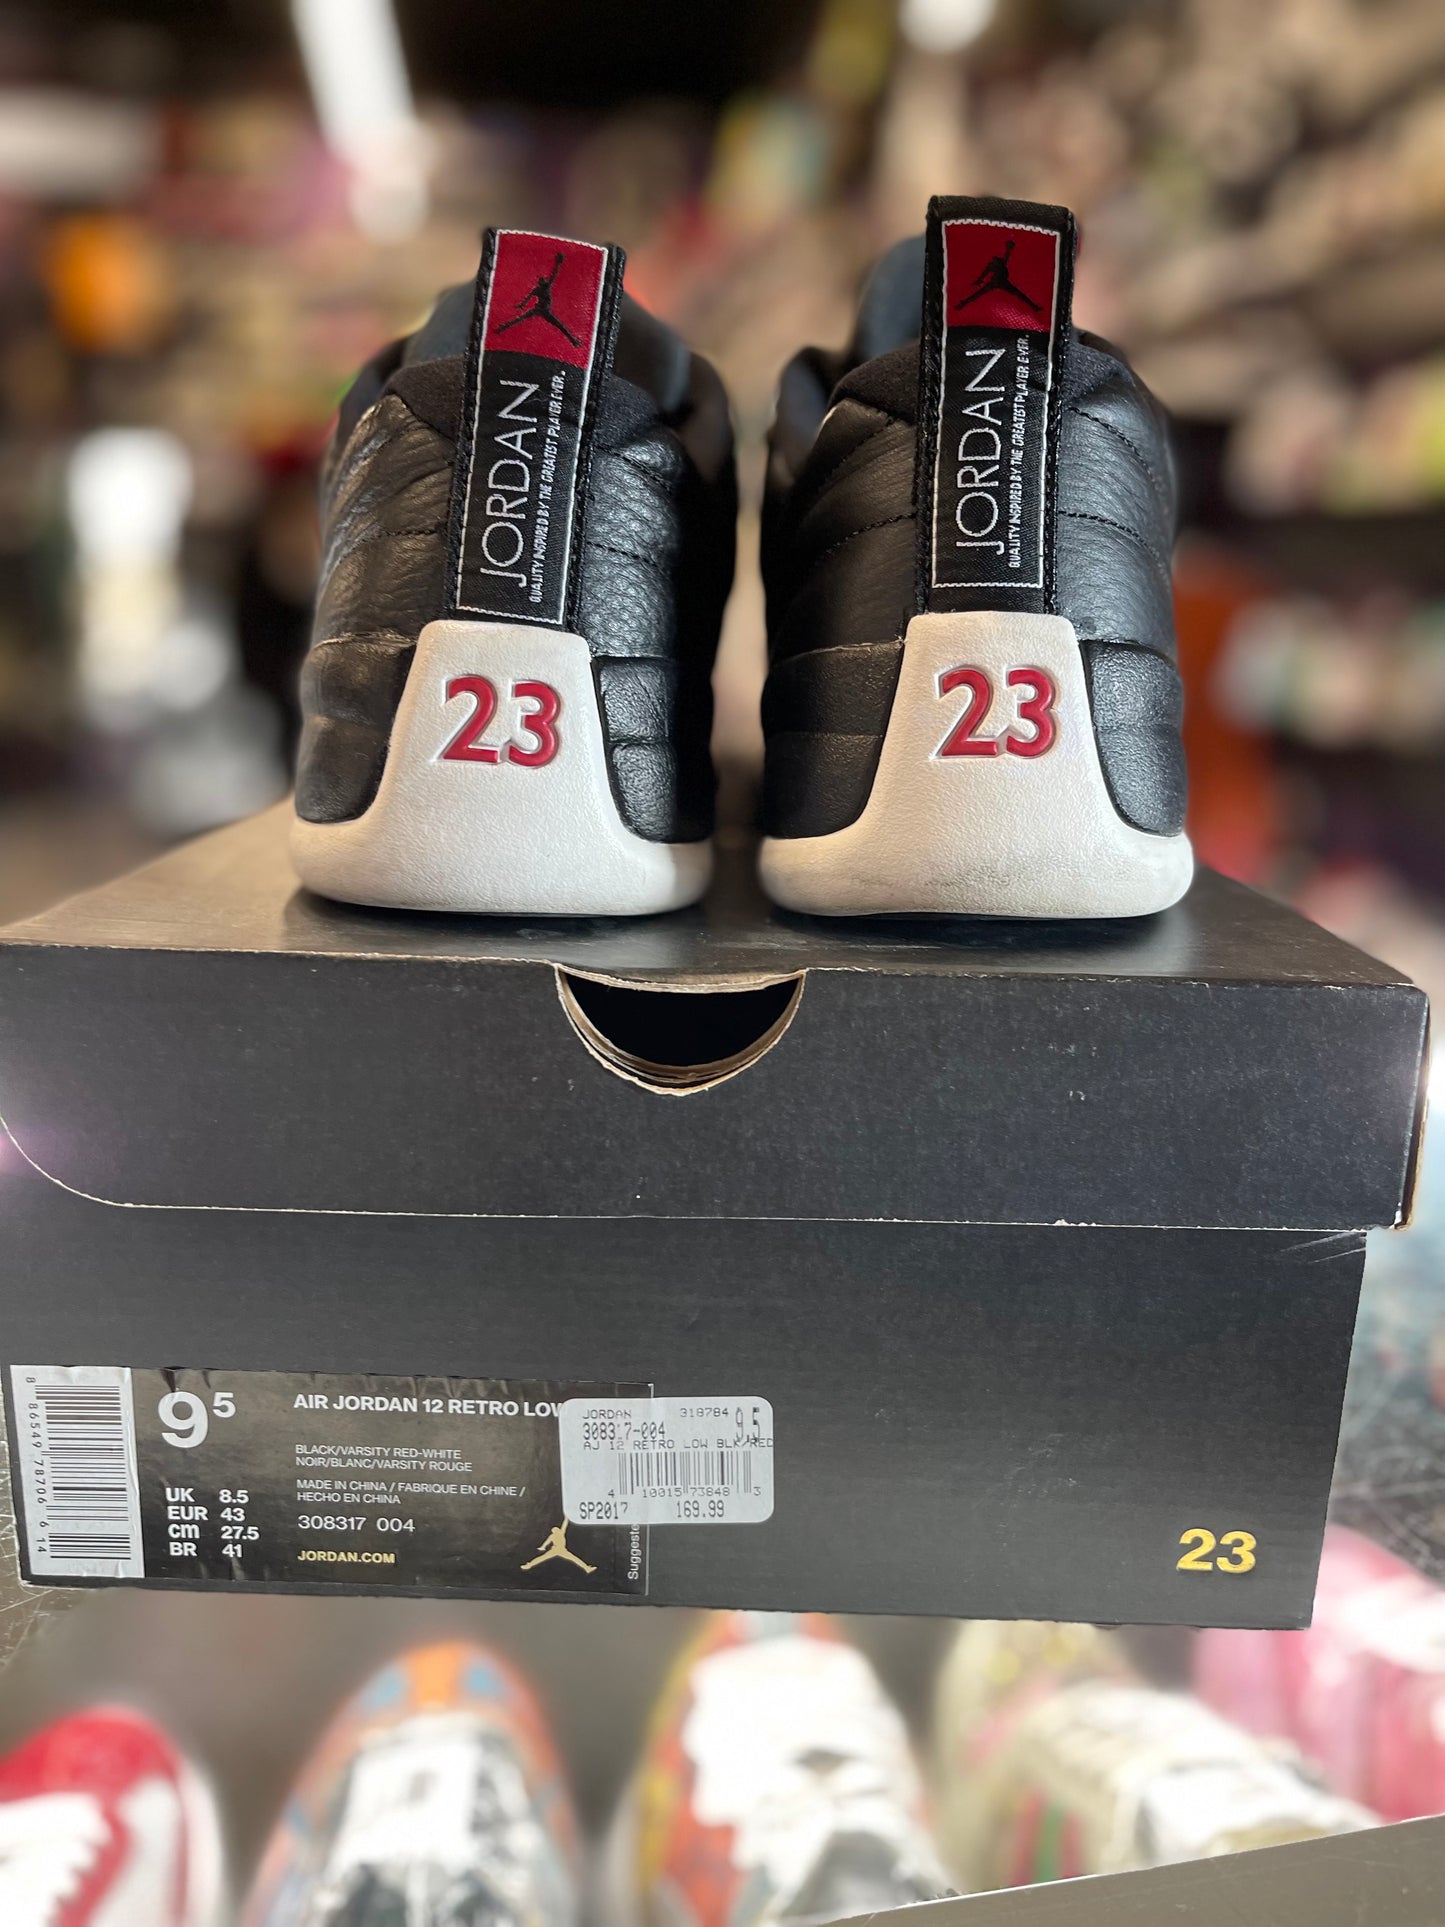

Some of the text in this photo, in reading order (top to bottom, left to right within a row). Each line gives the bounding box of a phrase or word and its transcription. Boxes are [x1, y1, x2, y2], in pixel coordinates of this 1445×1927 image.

[550, 370, 566, 400] EVER.
[547, 400, 562, 438] PLAYER
[955, 348, 1006, 556] JORDAN
[1008, 334, 1030, 569] QUALITY INSPIRED BY THE GREATEST PLAYER EVER.
[480, 380, 540, 588] JORDAN
[538, 483, 553, 500] THE
[536, 501, 550, 518] BY
[532, 518, 550, 560] INSPIRED
[528, 560, 545, 603] QUALITY
[438, 674, 561, 769] 23
[932, 665, 1058, 760] 23
[25, 1376, 37, 1384] 8
[293, 1393, 329, 1410] AIR
[332, 1395, 418, 1413] JORDAN
[422, 1398, 444, 1414] 12
[448, 1399, 520, 1416] RETRO
[582, 1407, 729, 1420] JORDAN 318784
[27, 1402, 43, 1449] 86549
[295, 1444, 462, 1460] BLACK/VARSITY RED-WHITE
[583, 1440, 600, 1451] AJ
[609, 1440, 625, 1451] 12
[633, 1439, 675, 1450] RETRO
[684, 1438, 709, 1449] LOW
[295, 1456, 473, 1472] NOIR/BLANC/VARSITY ROUGE
[33, 1459, 48, 1504] 78706
[296, 1479, 526, 1497] MADE IN CHINA / FABRIQUE EN CHINE /
[165, 1487, 250, 1504] UK 8.5
[296, 1491, 402, 1505] HECHO EN CHINA
[607, 1486, 761, 1498] 4 10015 73848 3
[167, 1505, 246, 1522] EUR 43
[579, 1500, 725, 1520] SP2017 169.99
[220, 1525, 261, 1541] 27.5
[297, 1514, 416, 1533] 308317 004
[169, 1541, 244, 1558] BR 41
[297, 1550, 396, 1564] JORDAN.COM
[627, 1523, 642, 1580] Suggeste
[1175, 1528, 1257, 1574] 23
